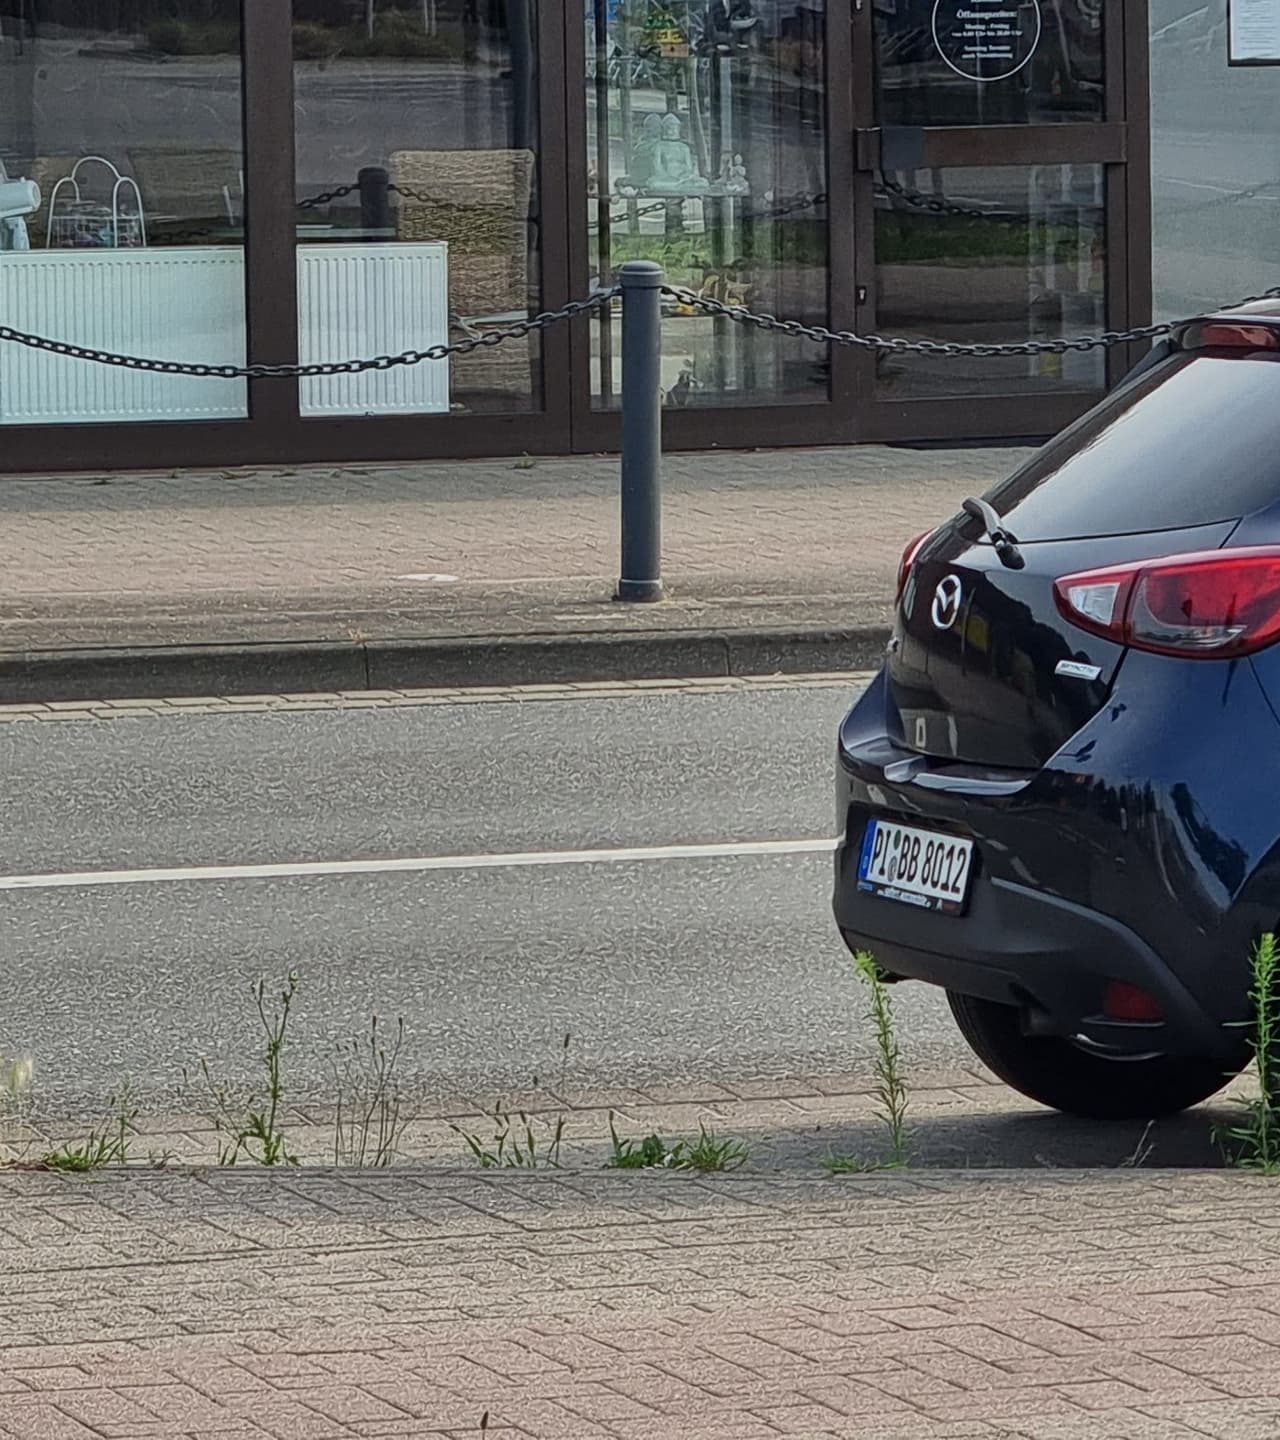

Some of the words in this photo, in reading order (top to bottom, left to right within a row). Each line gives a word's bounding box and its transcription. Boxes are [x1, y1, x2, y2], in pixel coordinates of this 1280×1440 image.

[870, 827, 892, 876] PI
[897, 834, 921, 883] BB
[921, 840, 967, 894] 8012
